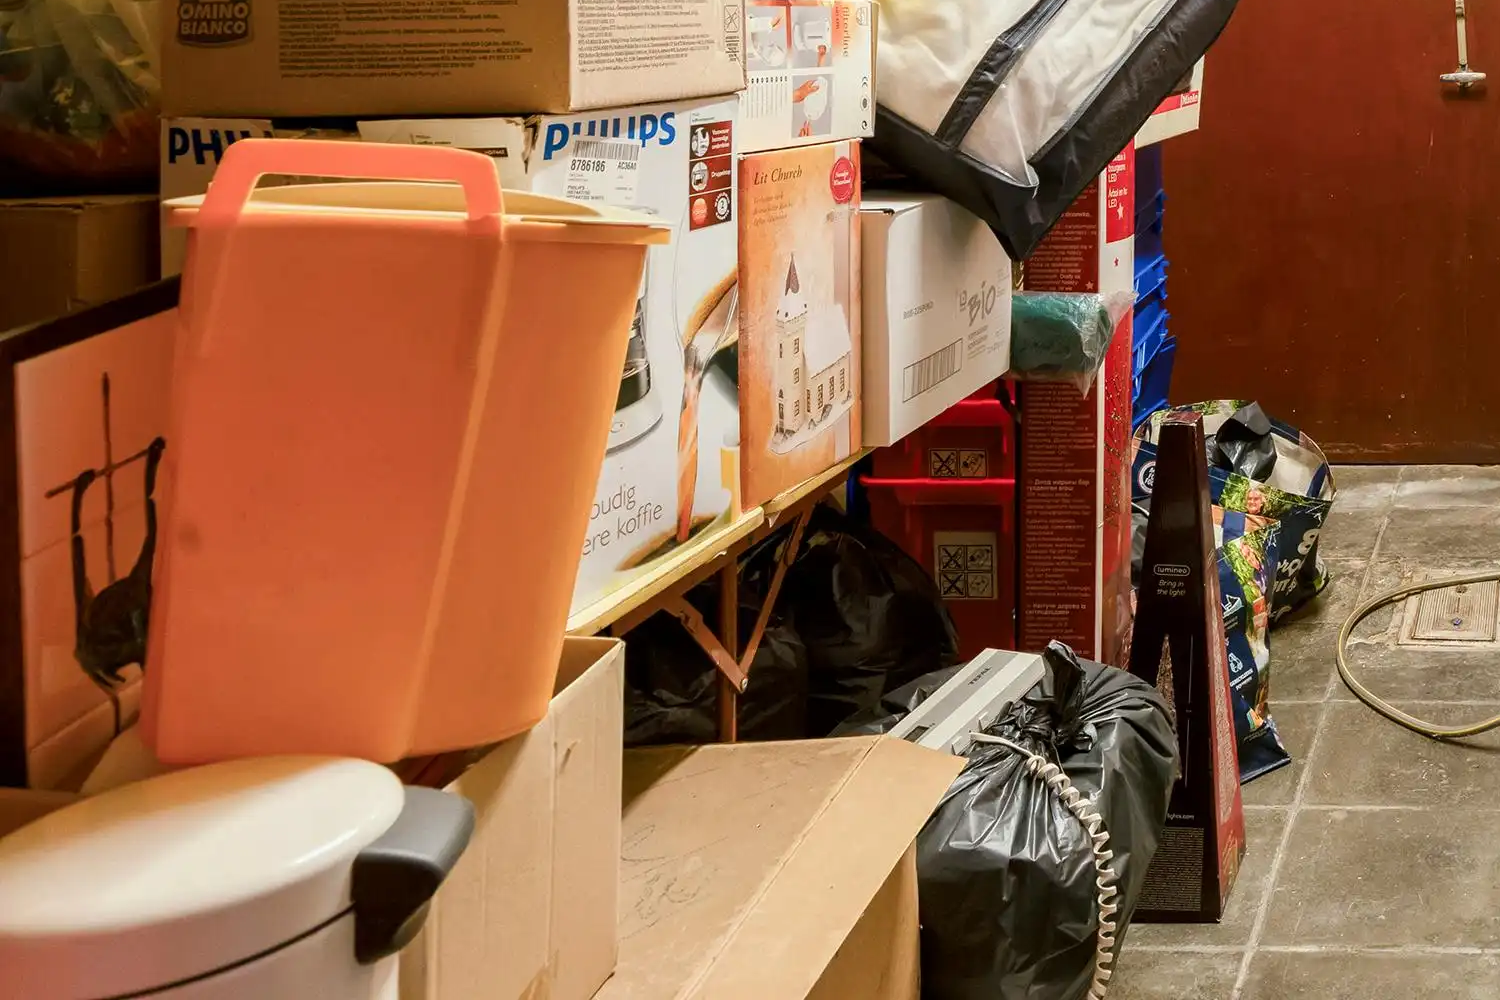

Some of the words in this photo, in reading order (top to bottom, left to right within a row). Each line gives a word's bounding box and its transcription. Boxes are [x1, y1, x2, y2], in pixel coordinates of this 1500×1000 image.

[180, 2, 249, 19] OMINO
[181, 20, 247, 35] BIANCO
[571, 159, 606, 172] 8786186
[753, 171, 768, 185] Lit
[771, 165, 803, 183] Church
[1108, 174, 1117, 183] LED
[1108, 199, 1117, 209] LED
[616, 502, 663, 540] koffie
[1157, 566, 1188, 574] lumineo
[1158, 580, 1177, 588] Bring
